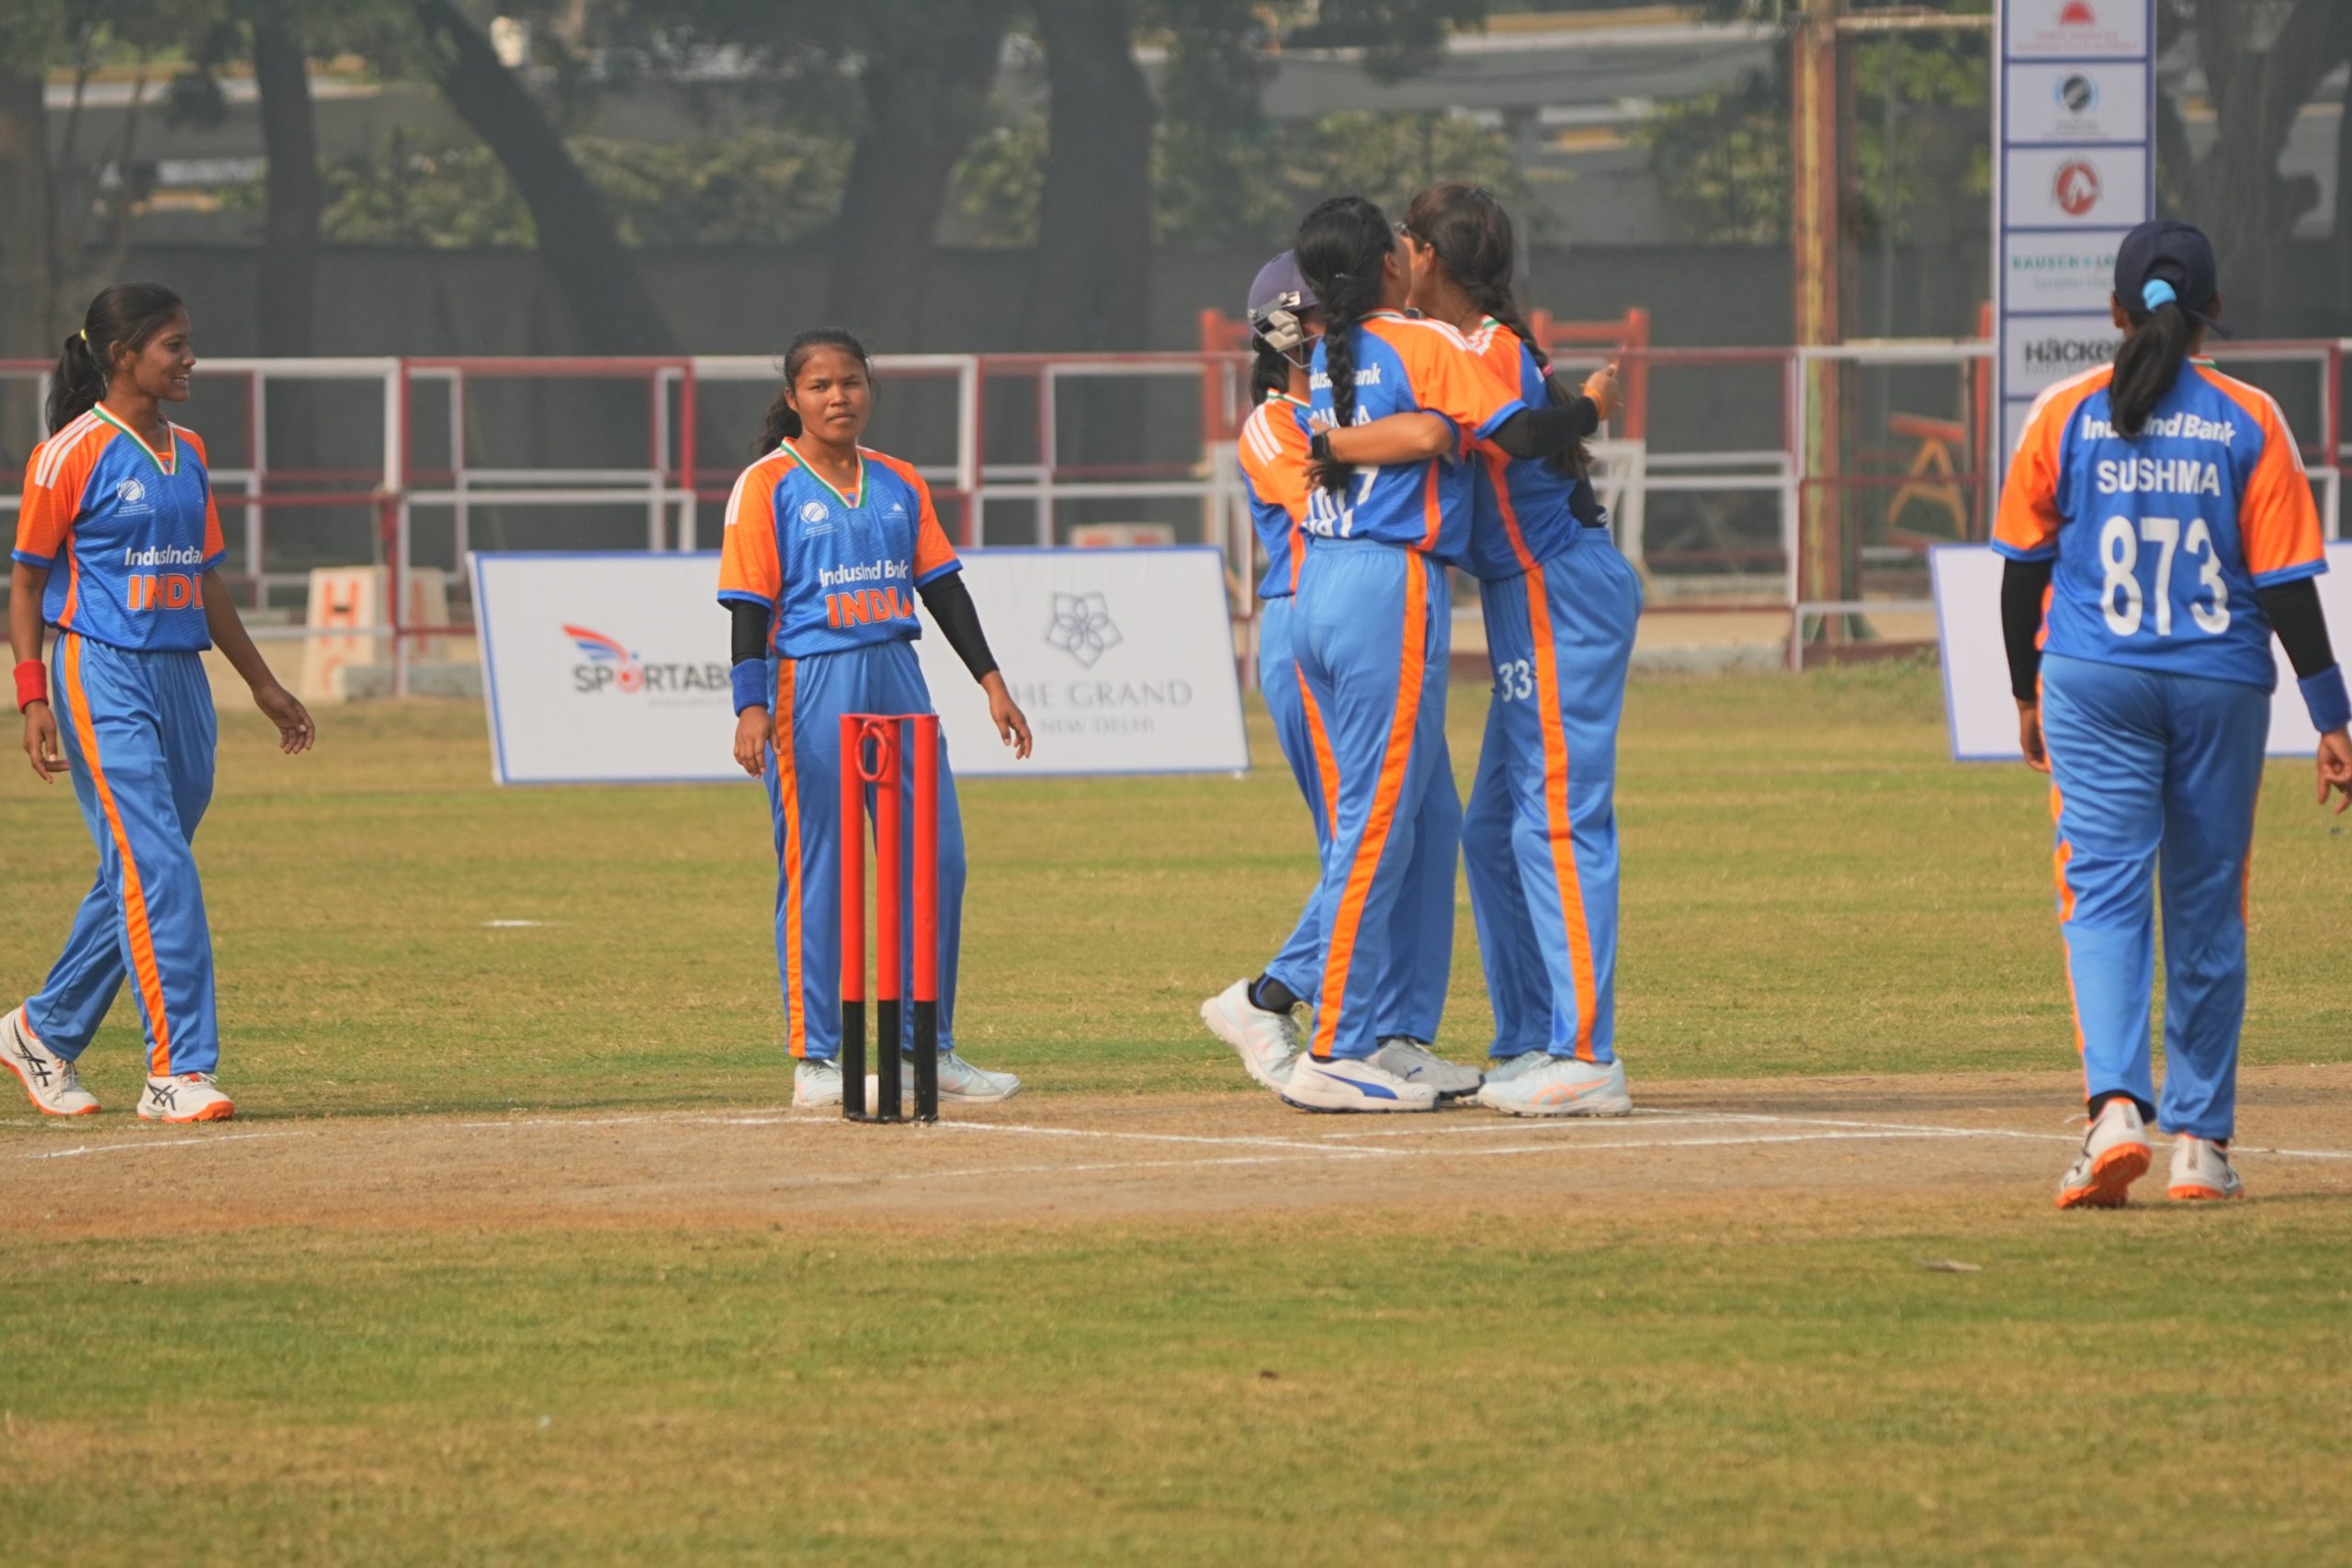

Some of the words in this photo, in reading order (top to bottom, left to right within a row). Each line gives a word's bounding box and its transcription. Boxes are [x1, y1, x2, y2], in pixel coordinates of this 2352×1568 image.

[1354, 363, 1381, 386] ank
[2183, 413, 2236, 446] Bank
[2097, 458, 2221, 497] SUSHMA
[127, 572, 204, 611] INDI
[2099, 515, 2231, 636] 873
[573, 663, 732, 693] SPORTAB
[1012, 680, 1054, 708] HE
[1069, 677, 1193, 709] GRAND
[1498, 659, 1532, 703] 33
[1040, 716, 1087, 734] NEW
[1094, 716, 1155, 733] DELHI
